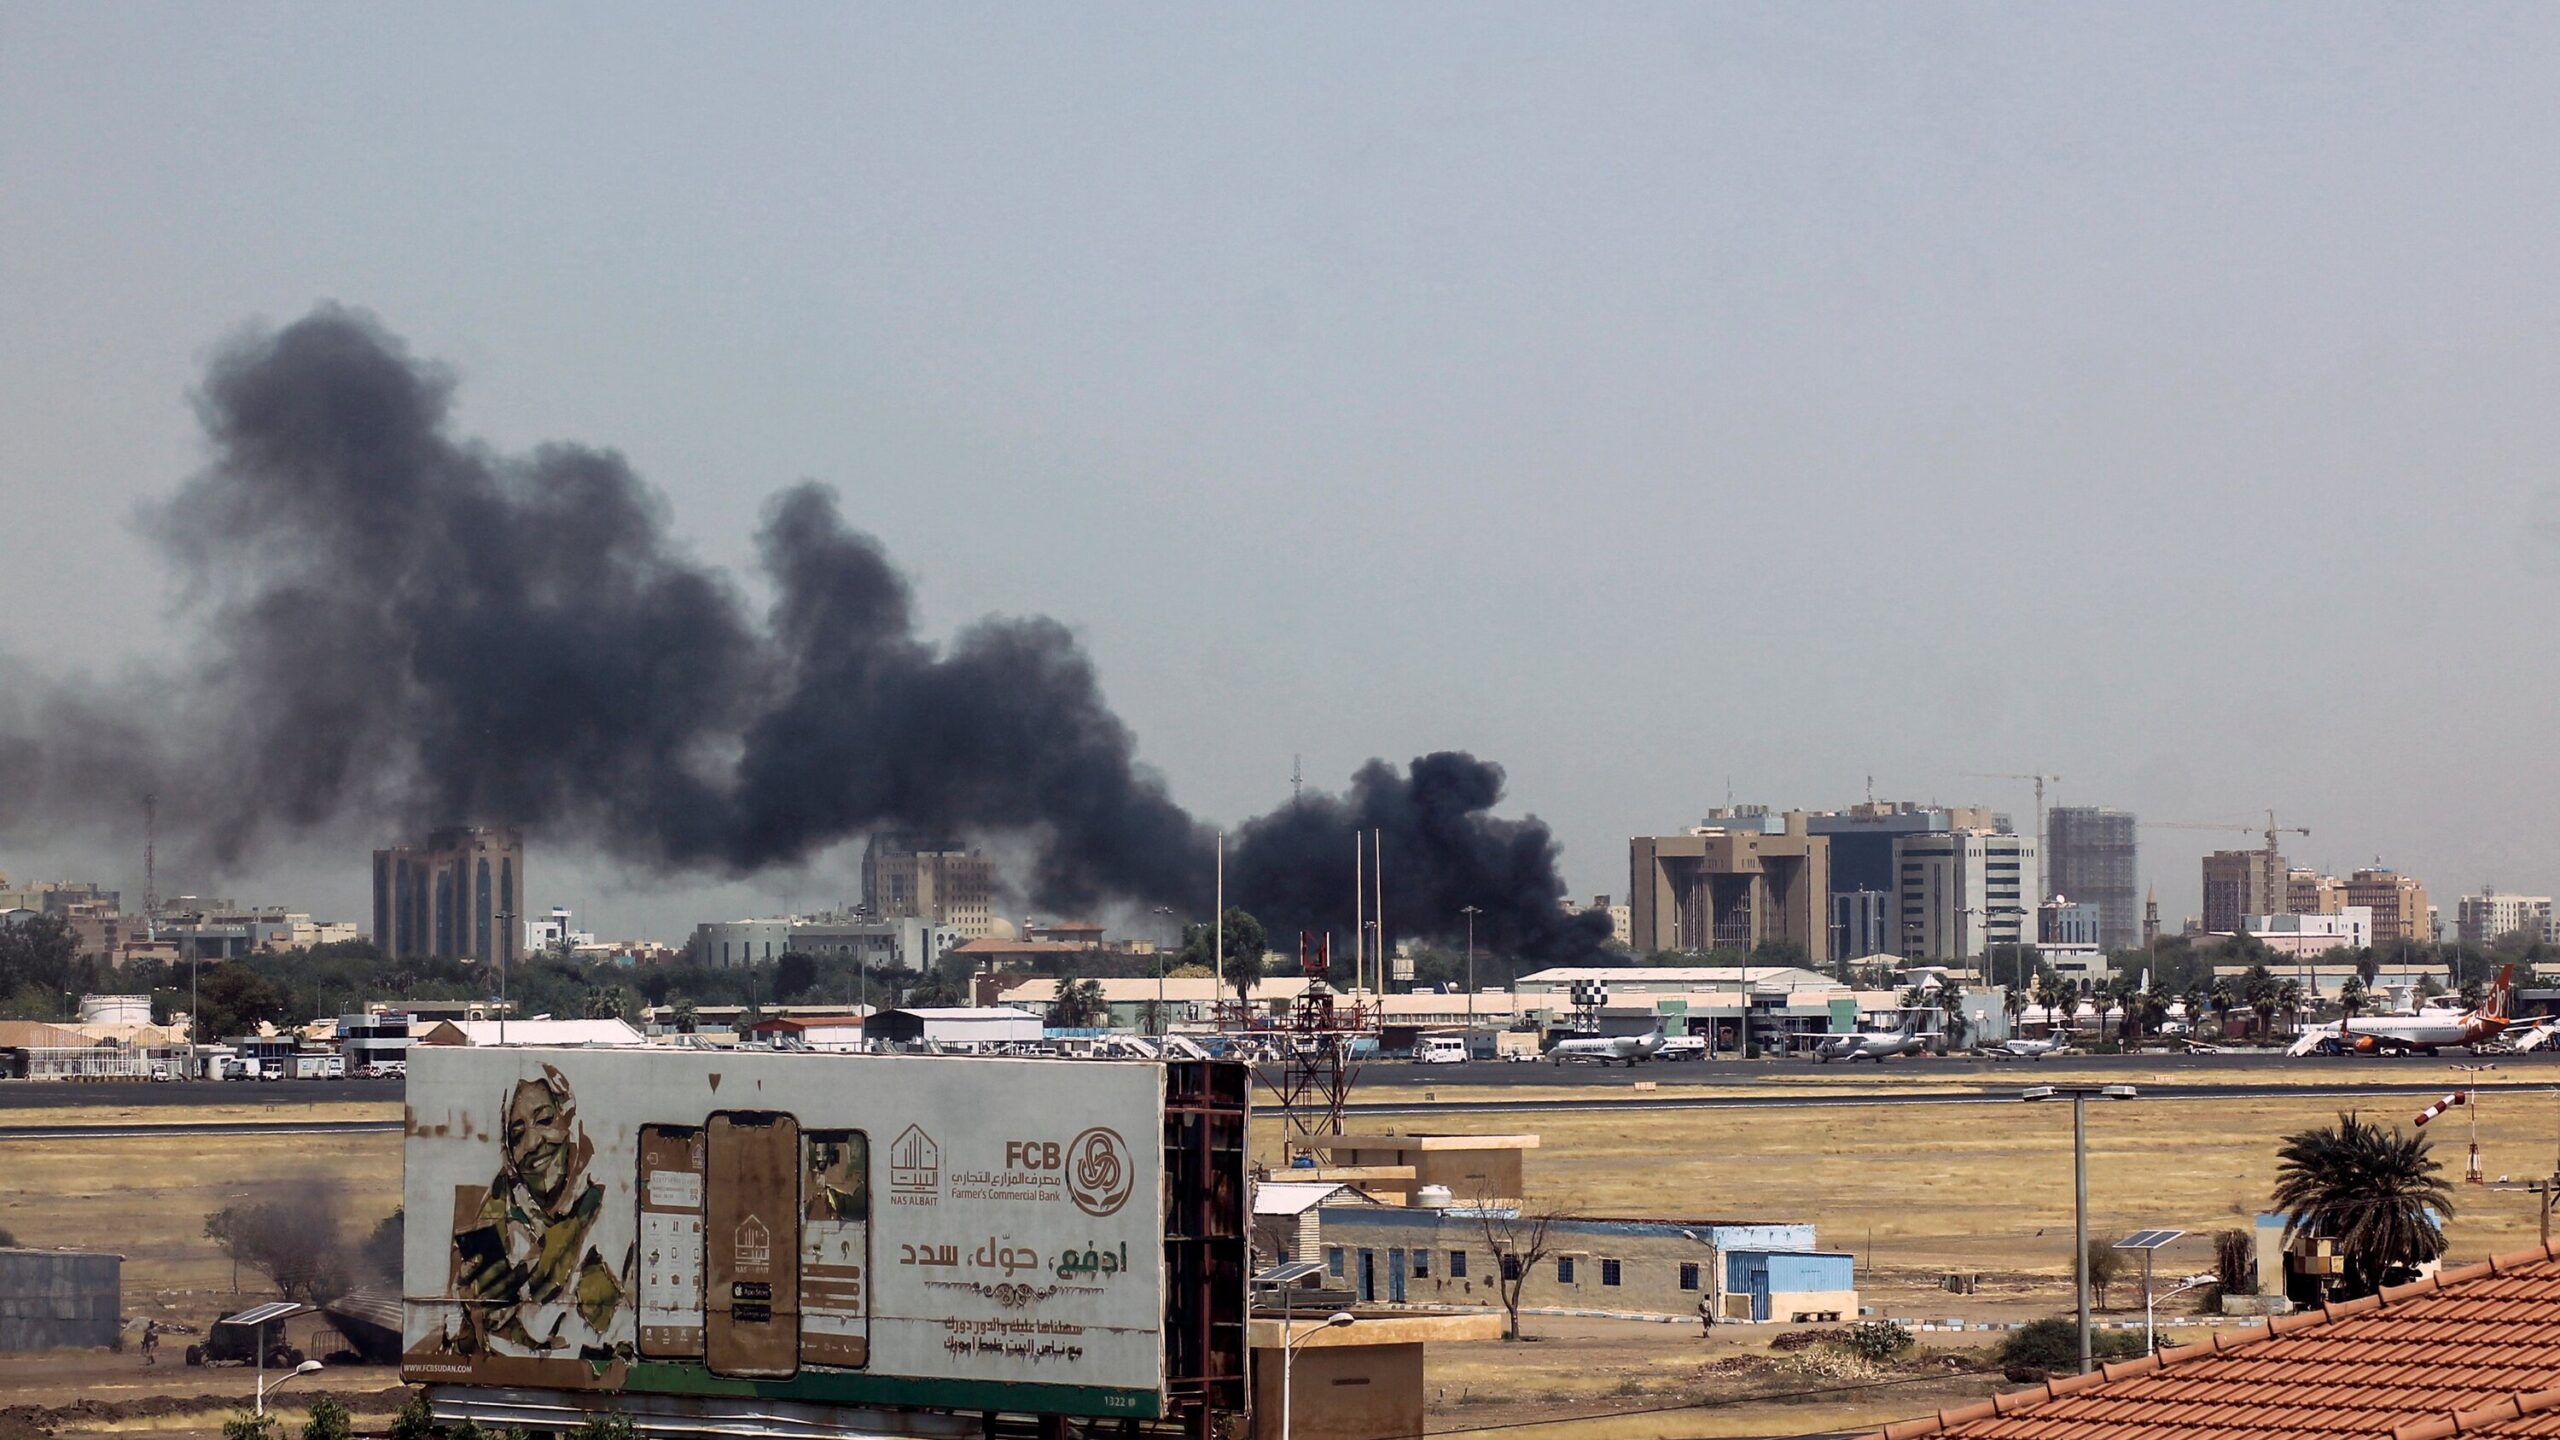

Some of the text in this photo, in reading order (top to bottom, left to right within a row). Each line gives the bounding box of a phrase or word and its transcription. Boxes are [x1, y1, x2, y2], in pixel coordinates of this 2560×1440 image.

[1006, 1141, 1061, 1170] FCB
[951, 1171, 1060, 1188] مصرف المزارع التجاري
[891, 1197, 938, 1206] NAS ALBAIT
[952, 1187, 1061, 1202] Farmer's Commercial Bank
[900, 1242, 958, 1266] سدد
[1104, 1395, 1125, 1407] 1322
